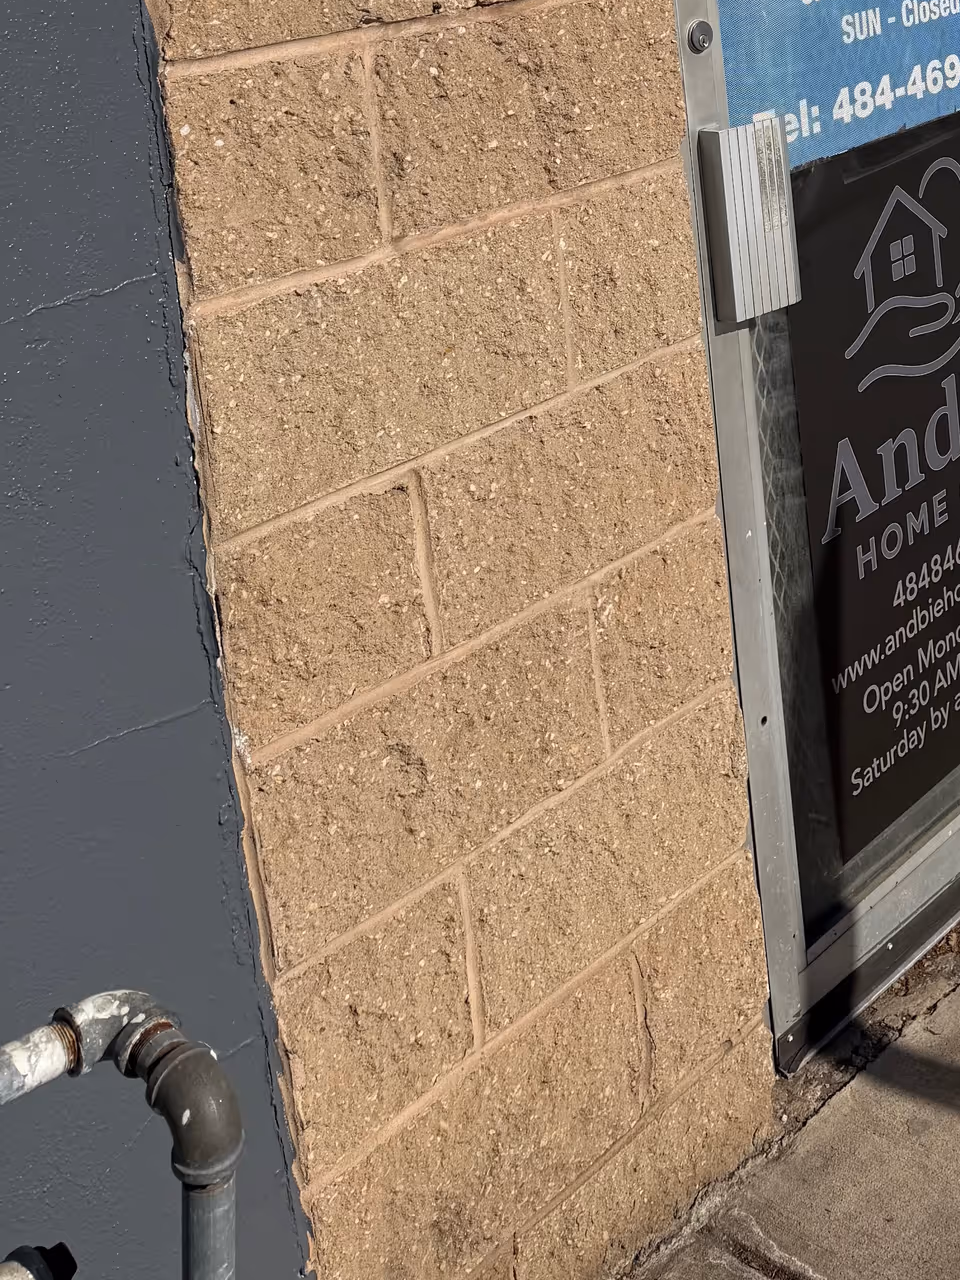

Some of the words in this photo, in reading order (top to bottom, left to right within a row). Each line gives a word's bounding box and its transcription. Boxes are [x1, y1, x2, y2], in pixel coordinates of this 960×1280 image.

[841, 7, 881, 44] SUN
[856, 489, 949, 580] HOME
[862, 659, 914, 715] Open
[891, 688, 930, 728] 9:30
[850, 723, 927, 797] Saturday
[930, 700, 951, 729] by
